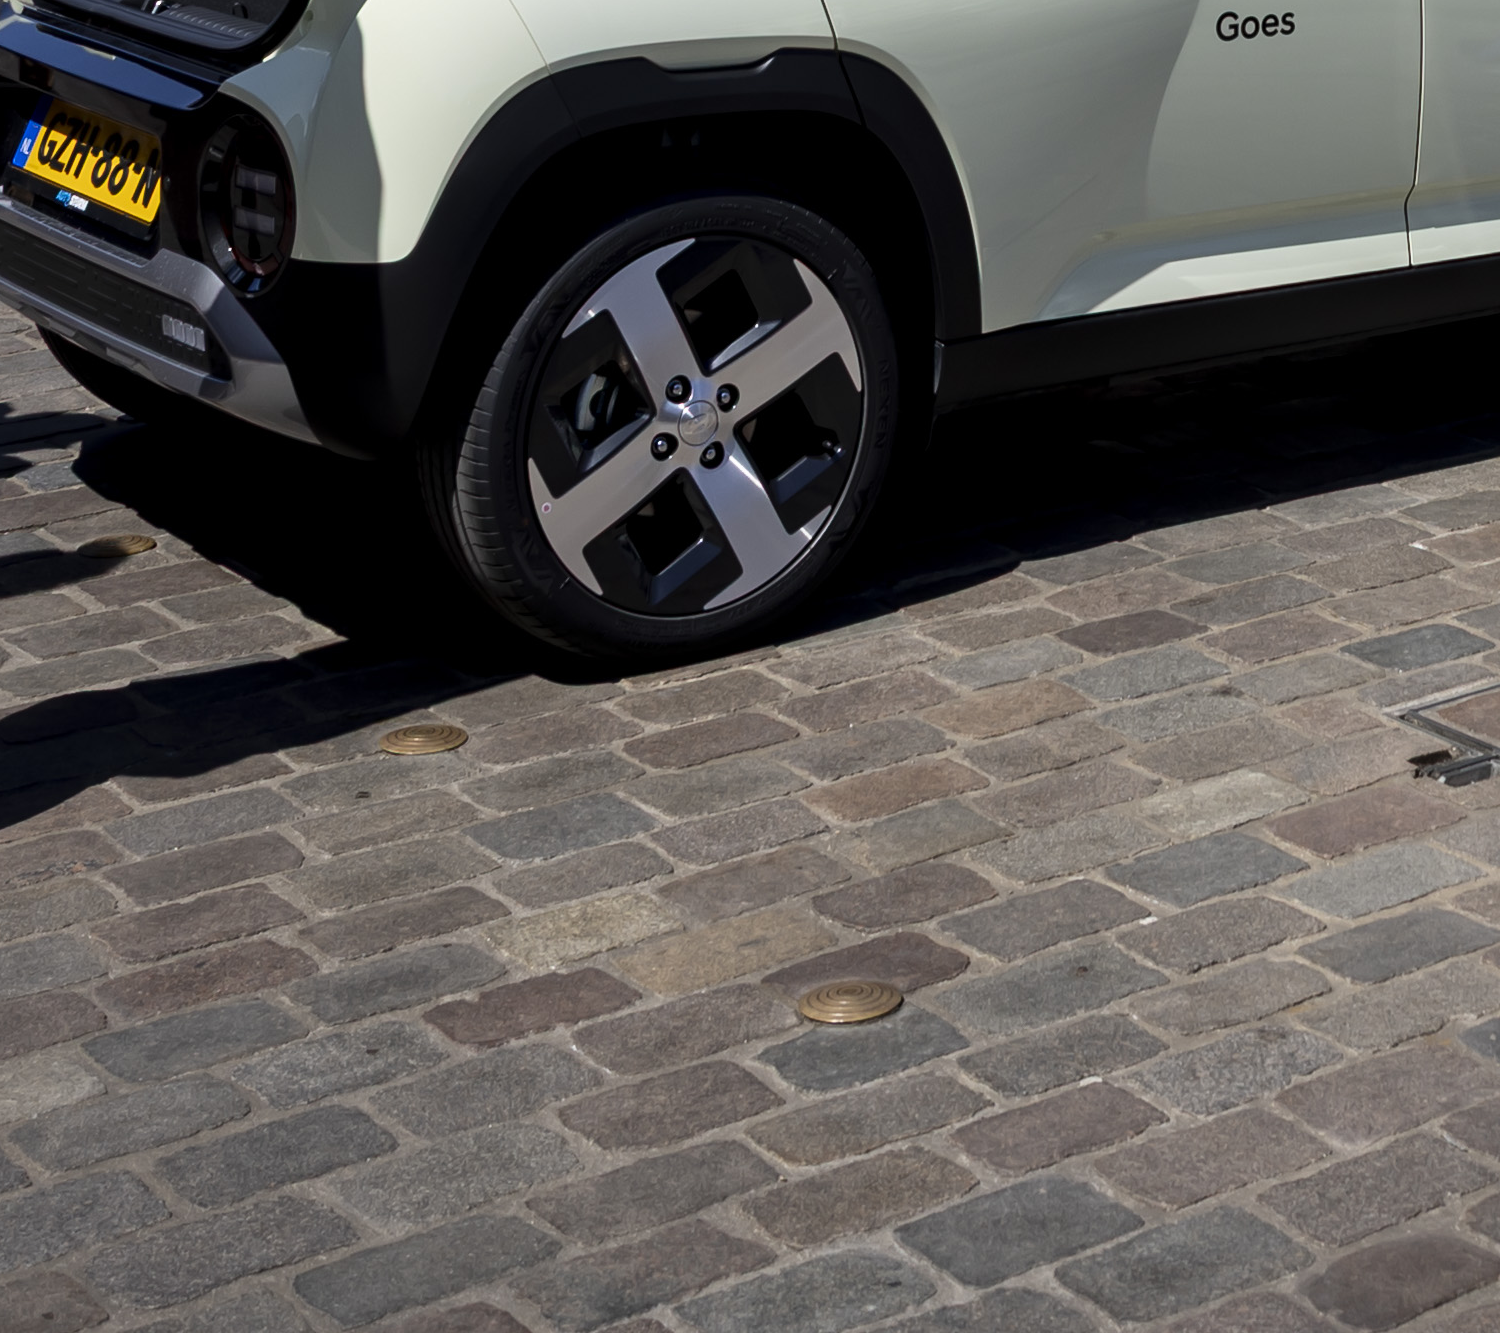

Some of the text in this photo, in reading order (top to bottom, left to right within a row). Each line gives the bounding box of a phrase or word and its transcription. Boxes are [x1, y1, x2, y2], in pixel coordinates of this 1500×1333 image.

[1215, 11, 1296, 42] Goes
[19, 137, 33, 155] NL
[37, 112, 161, 209] GZH-88-N
